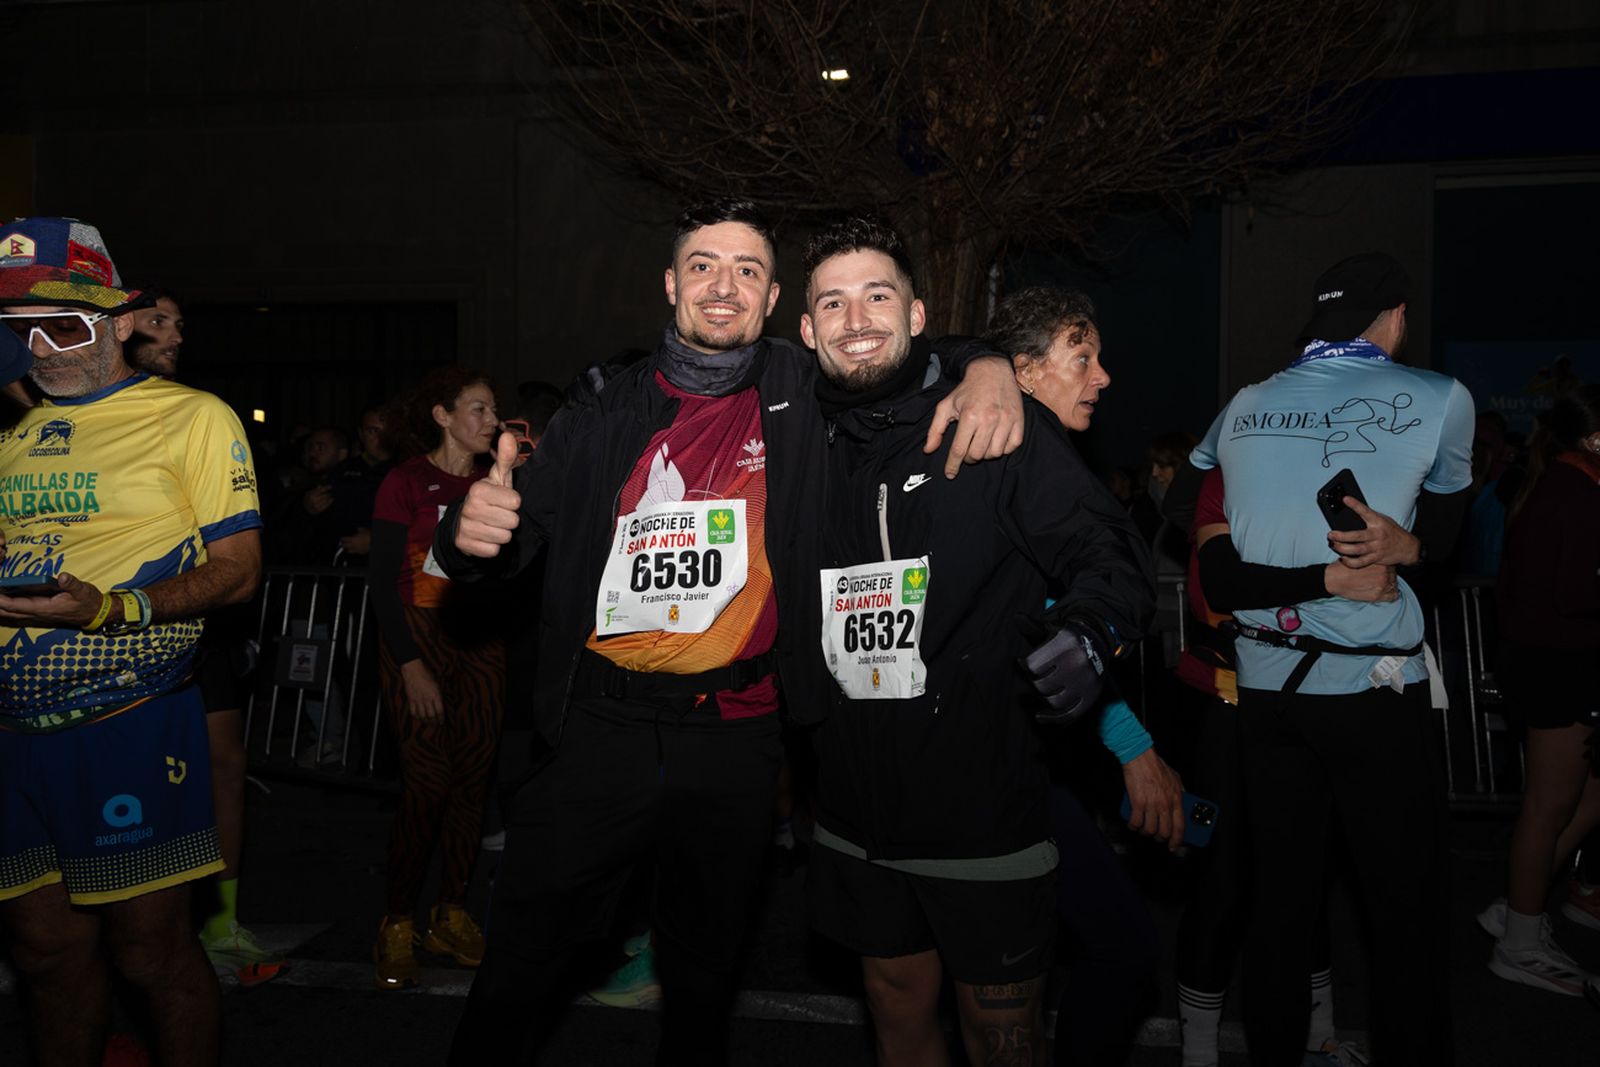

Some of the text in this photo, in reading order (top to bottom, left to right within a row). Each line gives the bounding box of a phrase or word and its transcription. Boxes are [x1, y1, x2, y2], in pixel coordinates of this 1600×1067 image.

[1233, 411, 1333, 433] ESMODEA
[73, 471, 98, 490] DE
[640, 516, 696, 534] NOCHE DE
[627, 537, 647, 555] SAN
[649, 530, 696, 549] ANTÓN
[629, 548, 722, 593] 6530
[849, 576, 893, 594] NOCHE DE
[640, 591, 710, 604] Francisco Javier
[835, 596, 855, 612] SAN
[856, 590, 892, 609] ANTÓN
[843, 608, 915, 653] 6532
[858, 654, 897, 665] Juan Antonio
[95, 826, 154, 847] axaragua
